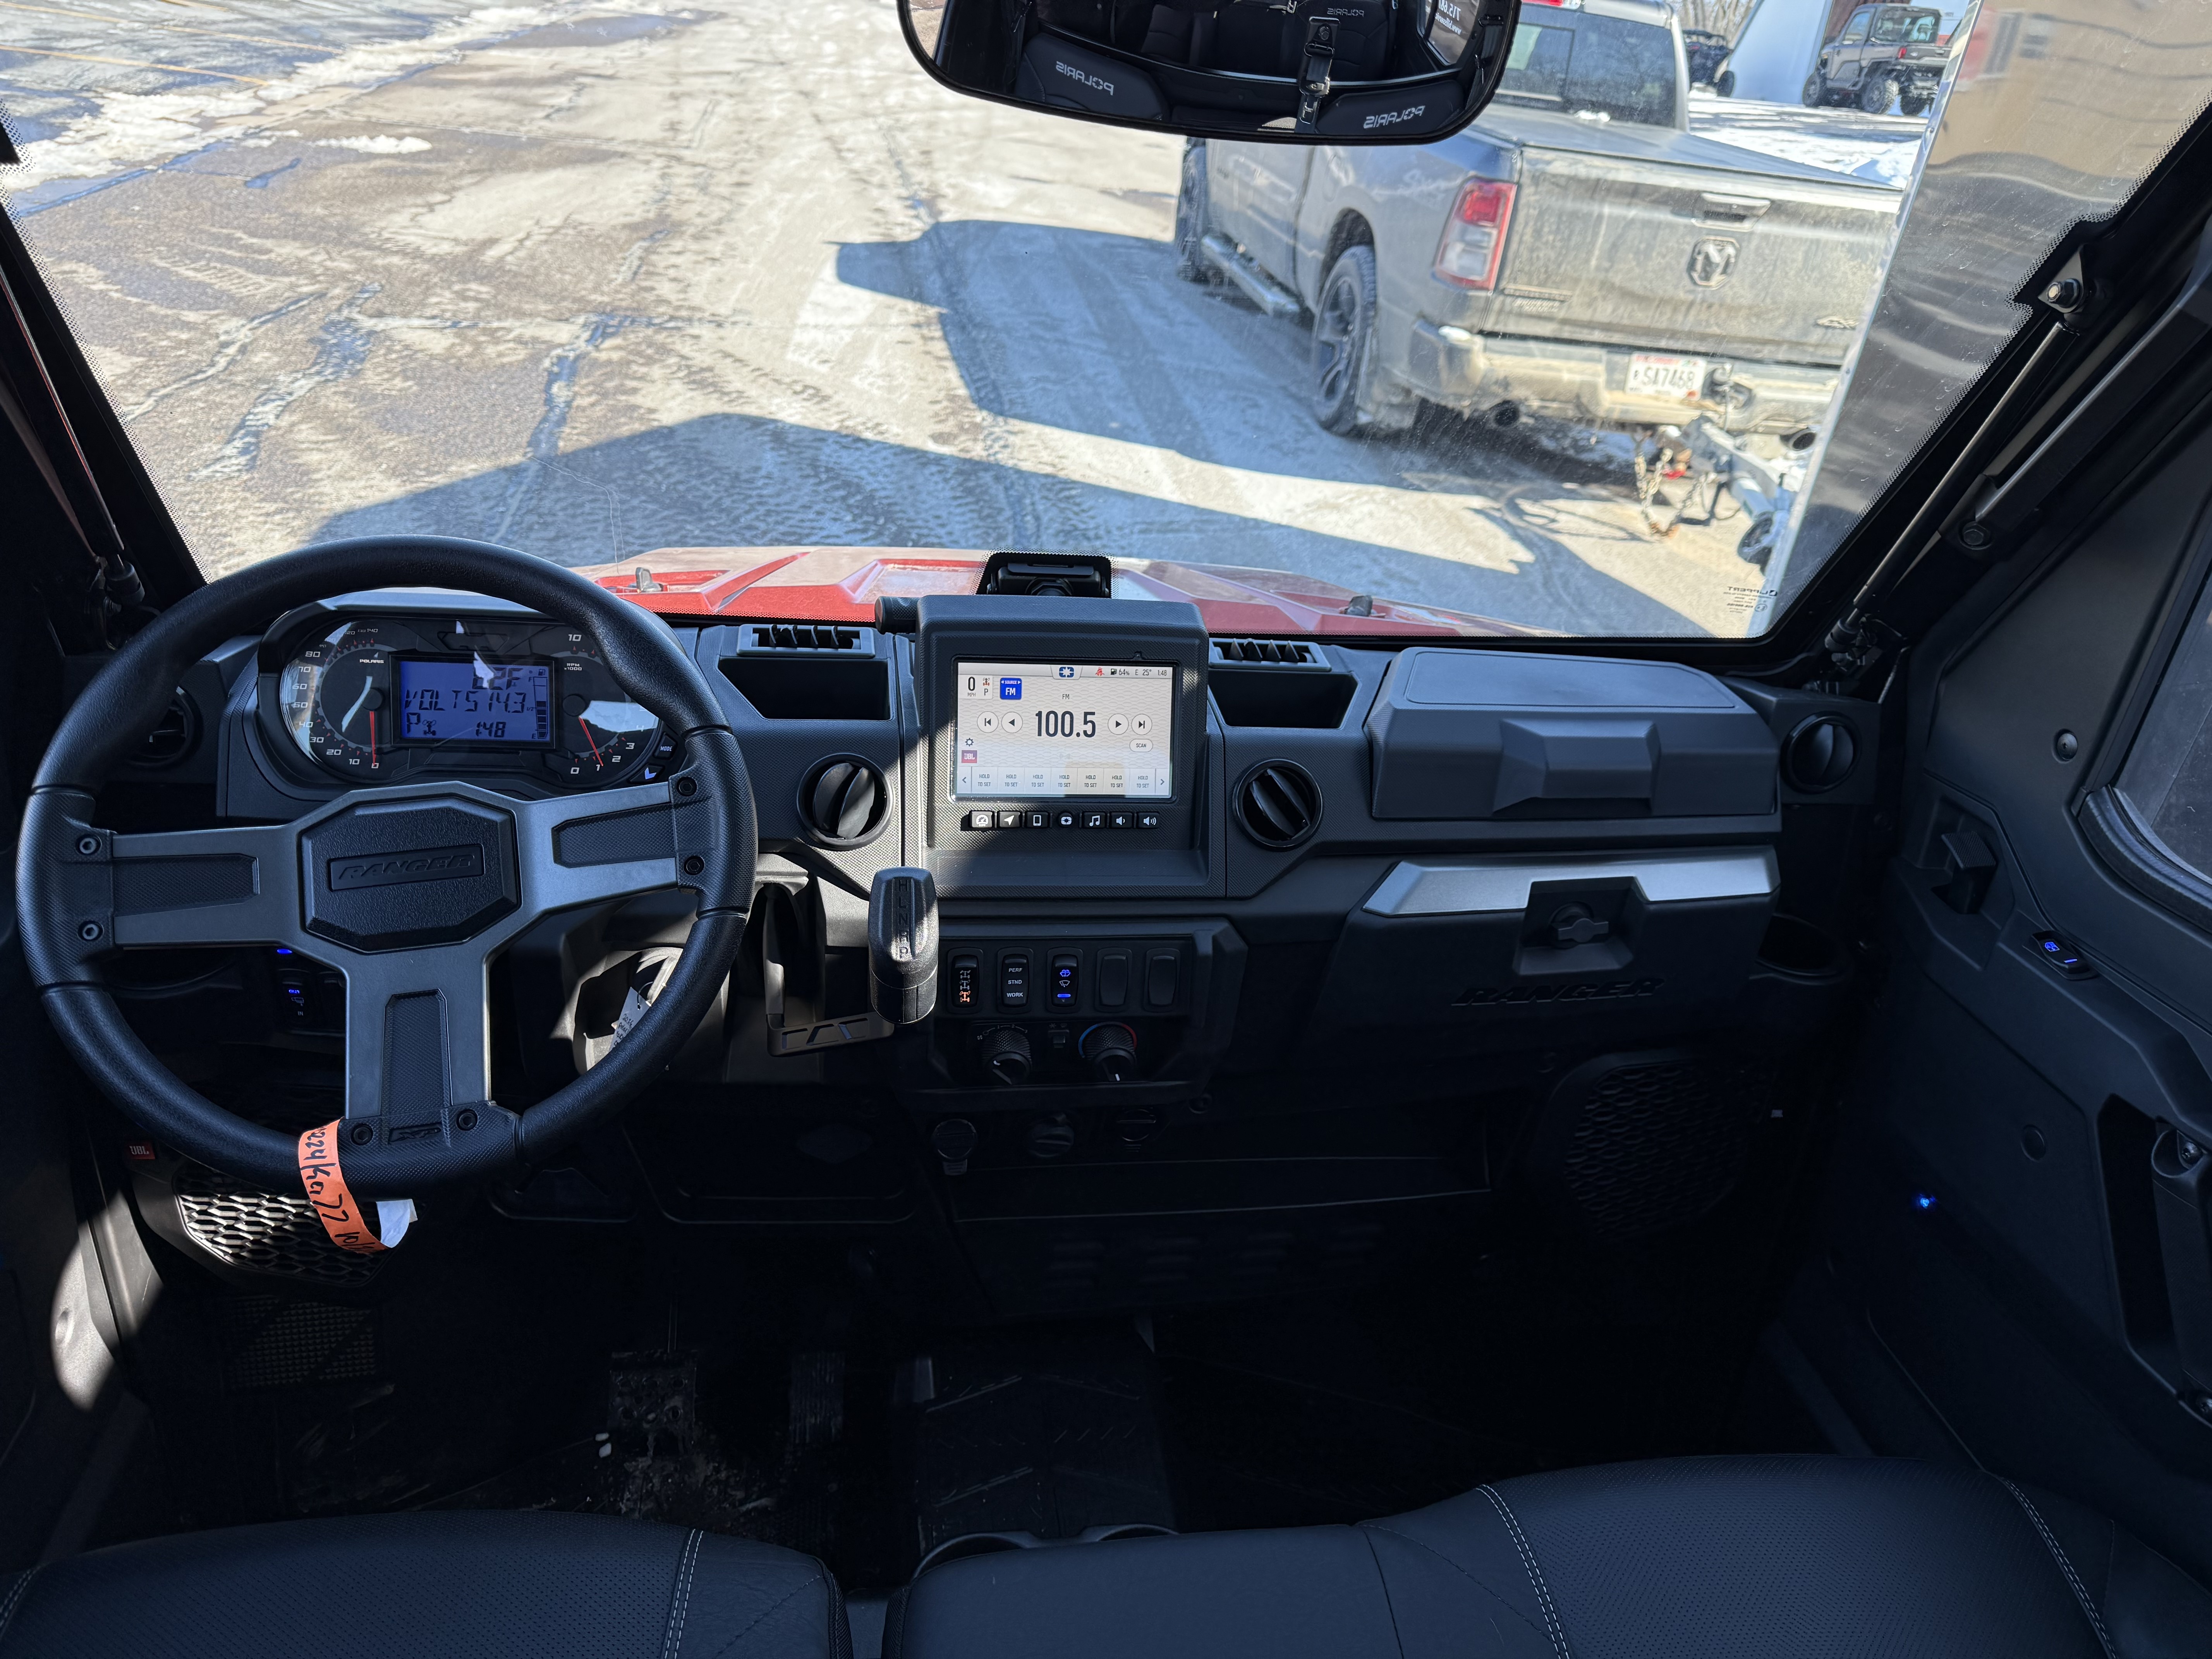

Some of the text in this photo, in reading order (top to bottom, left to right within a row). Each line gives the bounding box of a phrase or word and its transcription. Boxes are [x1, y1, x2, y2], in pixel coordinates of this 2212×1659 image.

[968, 677, 975, 691] 0
[476, 721, 507, 738] 1:48
[1035, 711, 1096, 738] 100.5
[338, 854, 475, 879] RANGER
[898, 879, 908, 891] H
[898, 897, 908, 908] L
[898, 915, 909, 925] N
[899, 947, 908, 958] P
[1451, 977, 1665, 1006] RANGER
[129, 1146, 149, 1155] JBL
